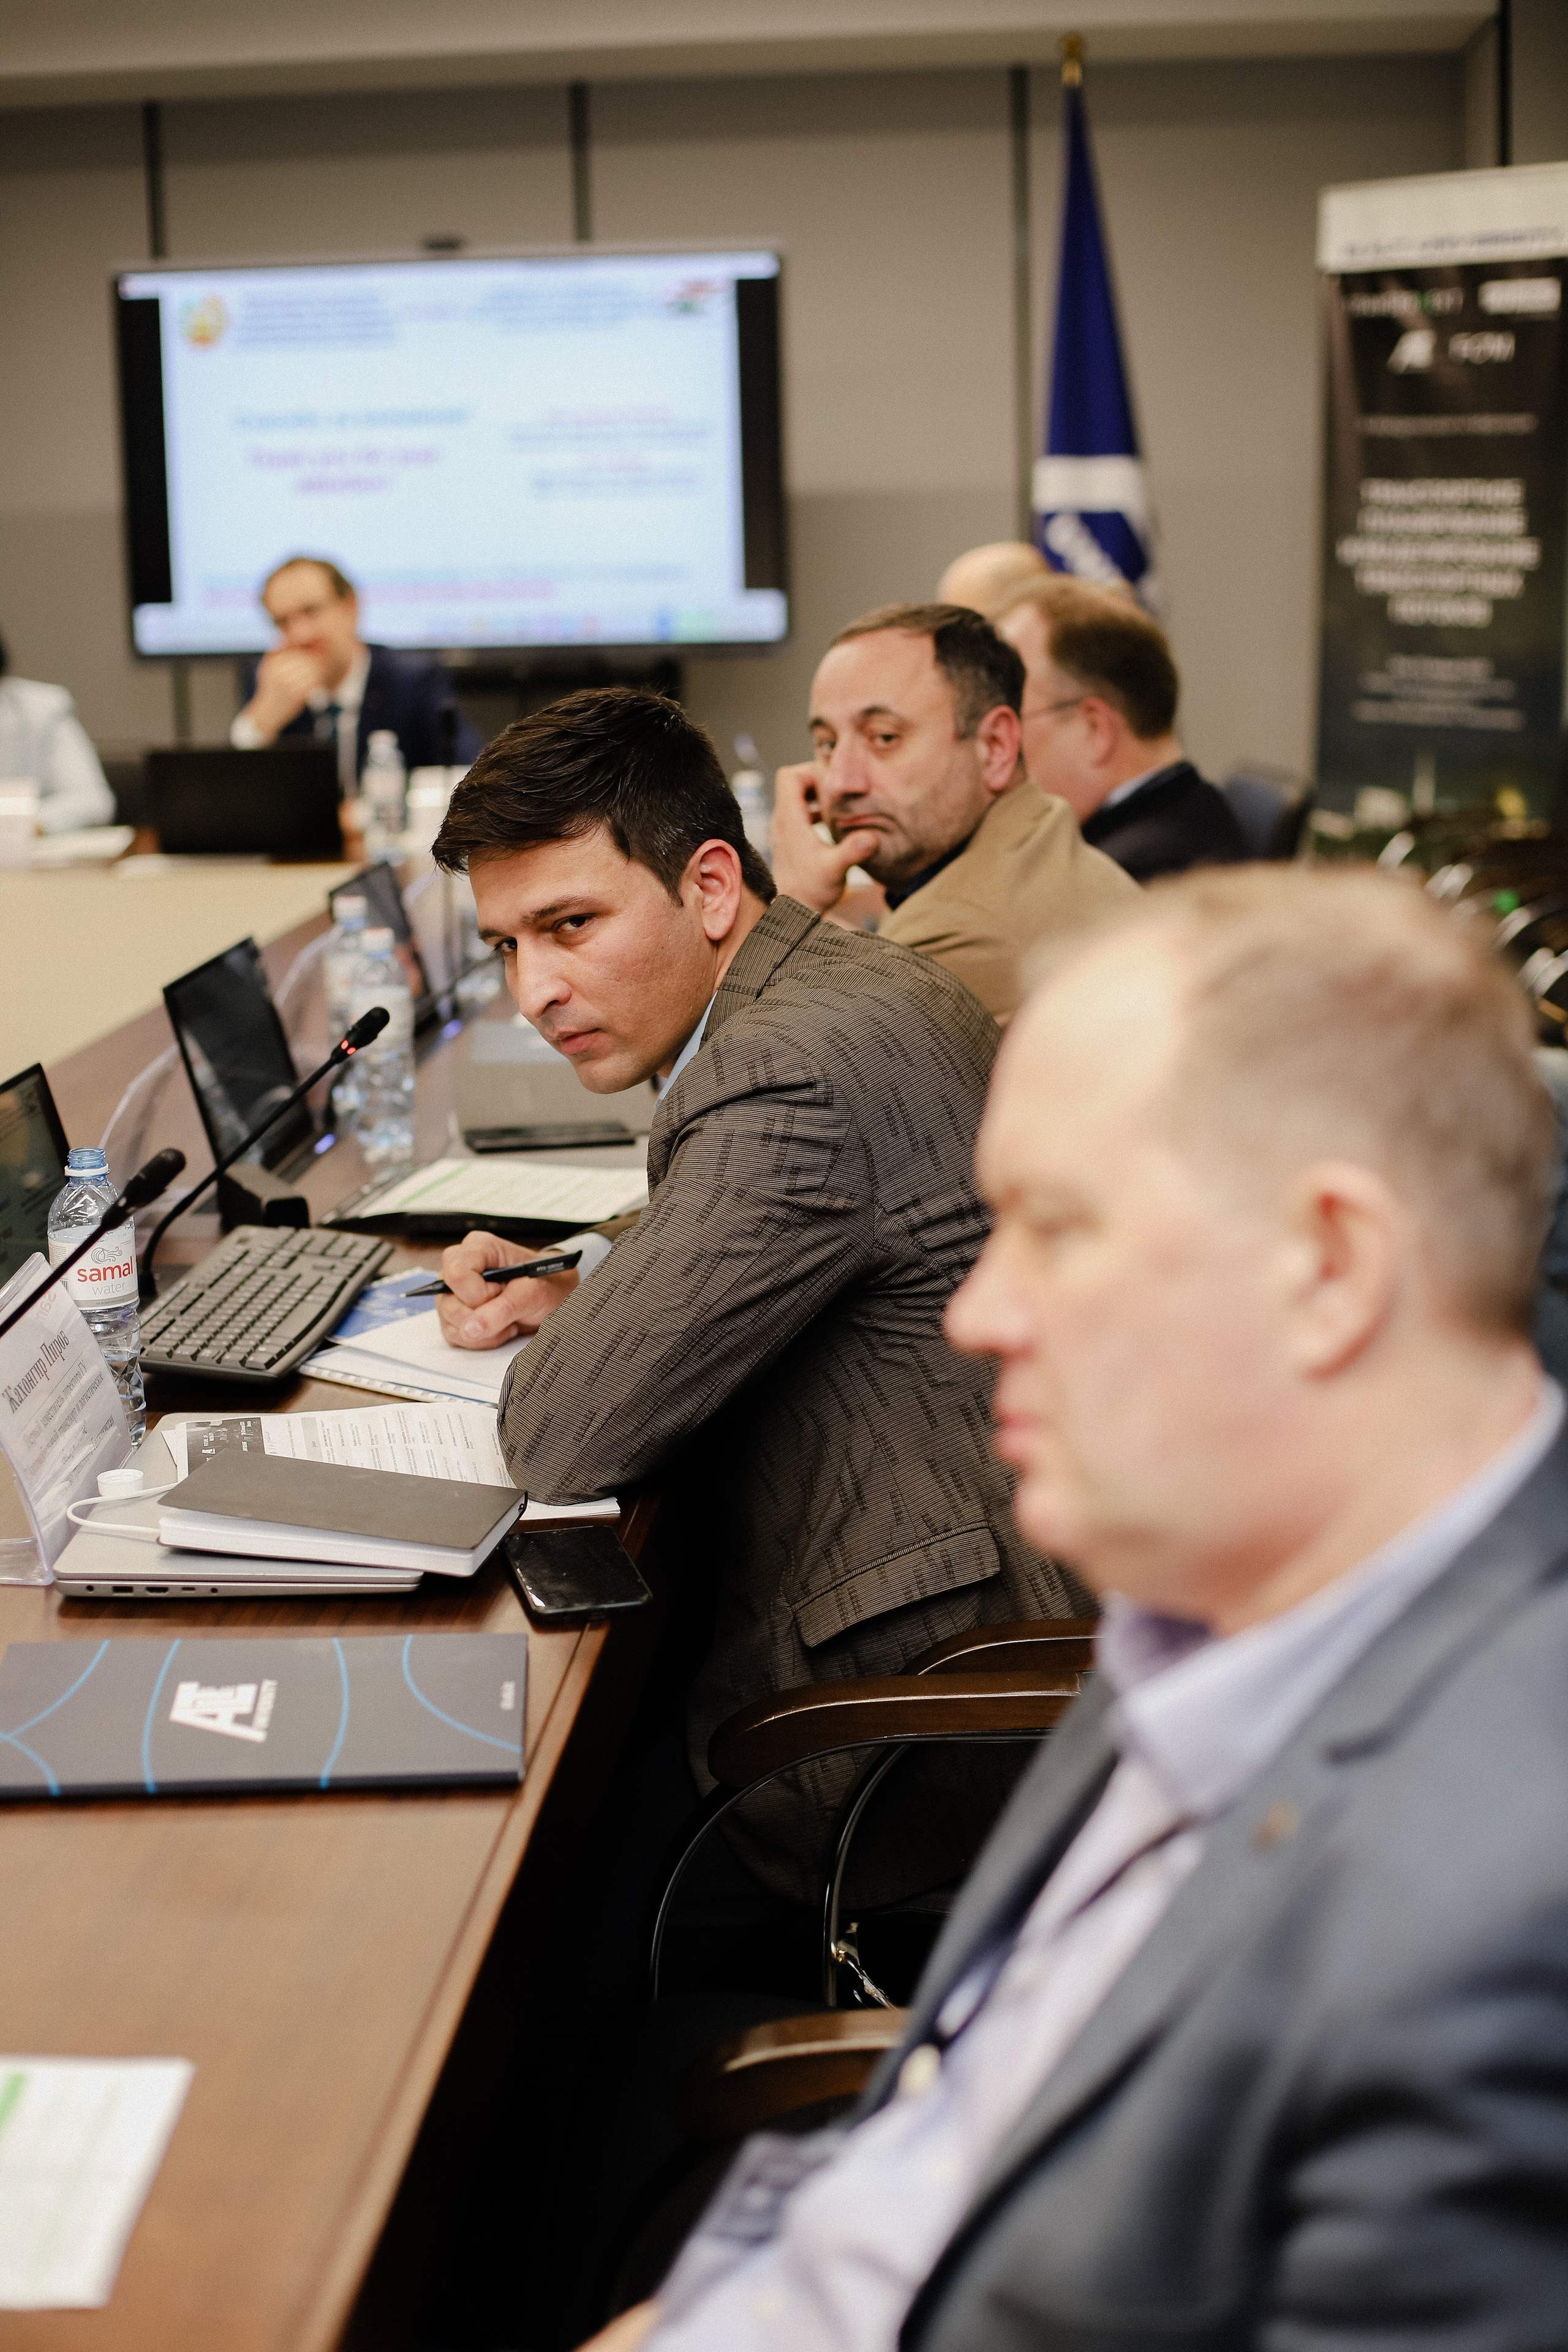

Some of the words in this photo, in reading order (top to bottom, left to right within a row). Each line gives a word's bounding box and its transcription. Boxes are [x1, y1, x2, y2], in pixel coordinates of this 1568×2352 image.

[77, 1256, 133, 1283] samal
[92, 1282, 125, 1295] water
[2, 1358, 50, 1414] Жахонгир
[40, 1330, 69, 1367] Пиров
